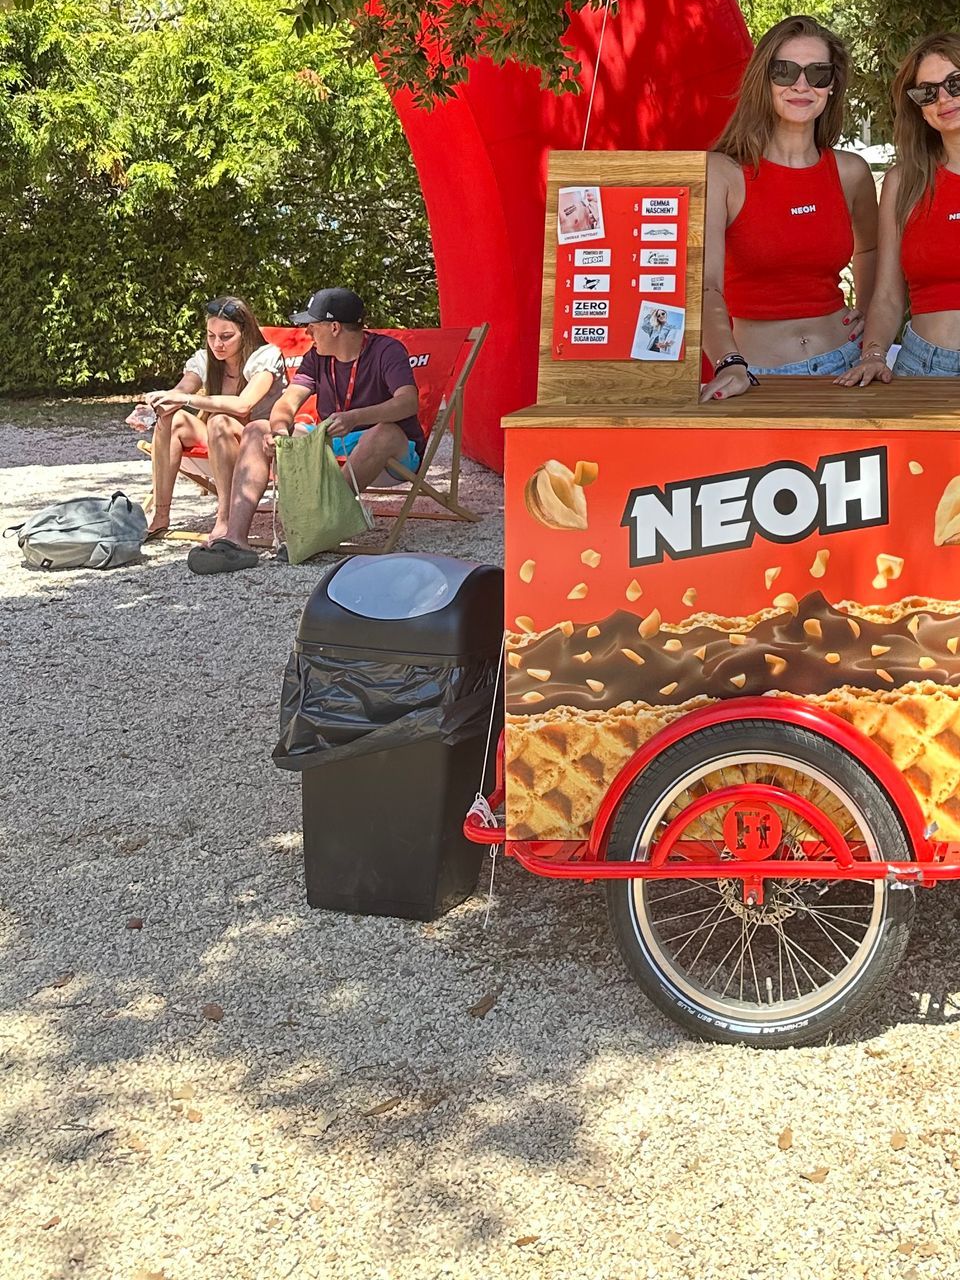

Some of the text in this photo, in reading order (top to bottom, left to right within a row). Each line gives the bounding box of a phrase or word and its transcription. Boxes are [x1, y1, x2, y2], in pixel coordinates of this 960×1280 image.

[790, 204, 816, 216] NEOH
[565, 279, 571, 288] 2
[564, 304, 570, 314] 3
[574, 301, 607, 310] ZERO
[574, 327, 605, 336] ZERO
[625, 449, 886, 563] NEOH
[676, 1000, 695, 1015] PLUS
